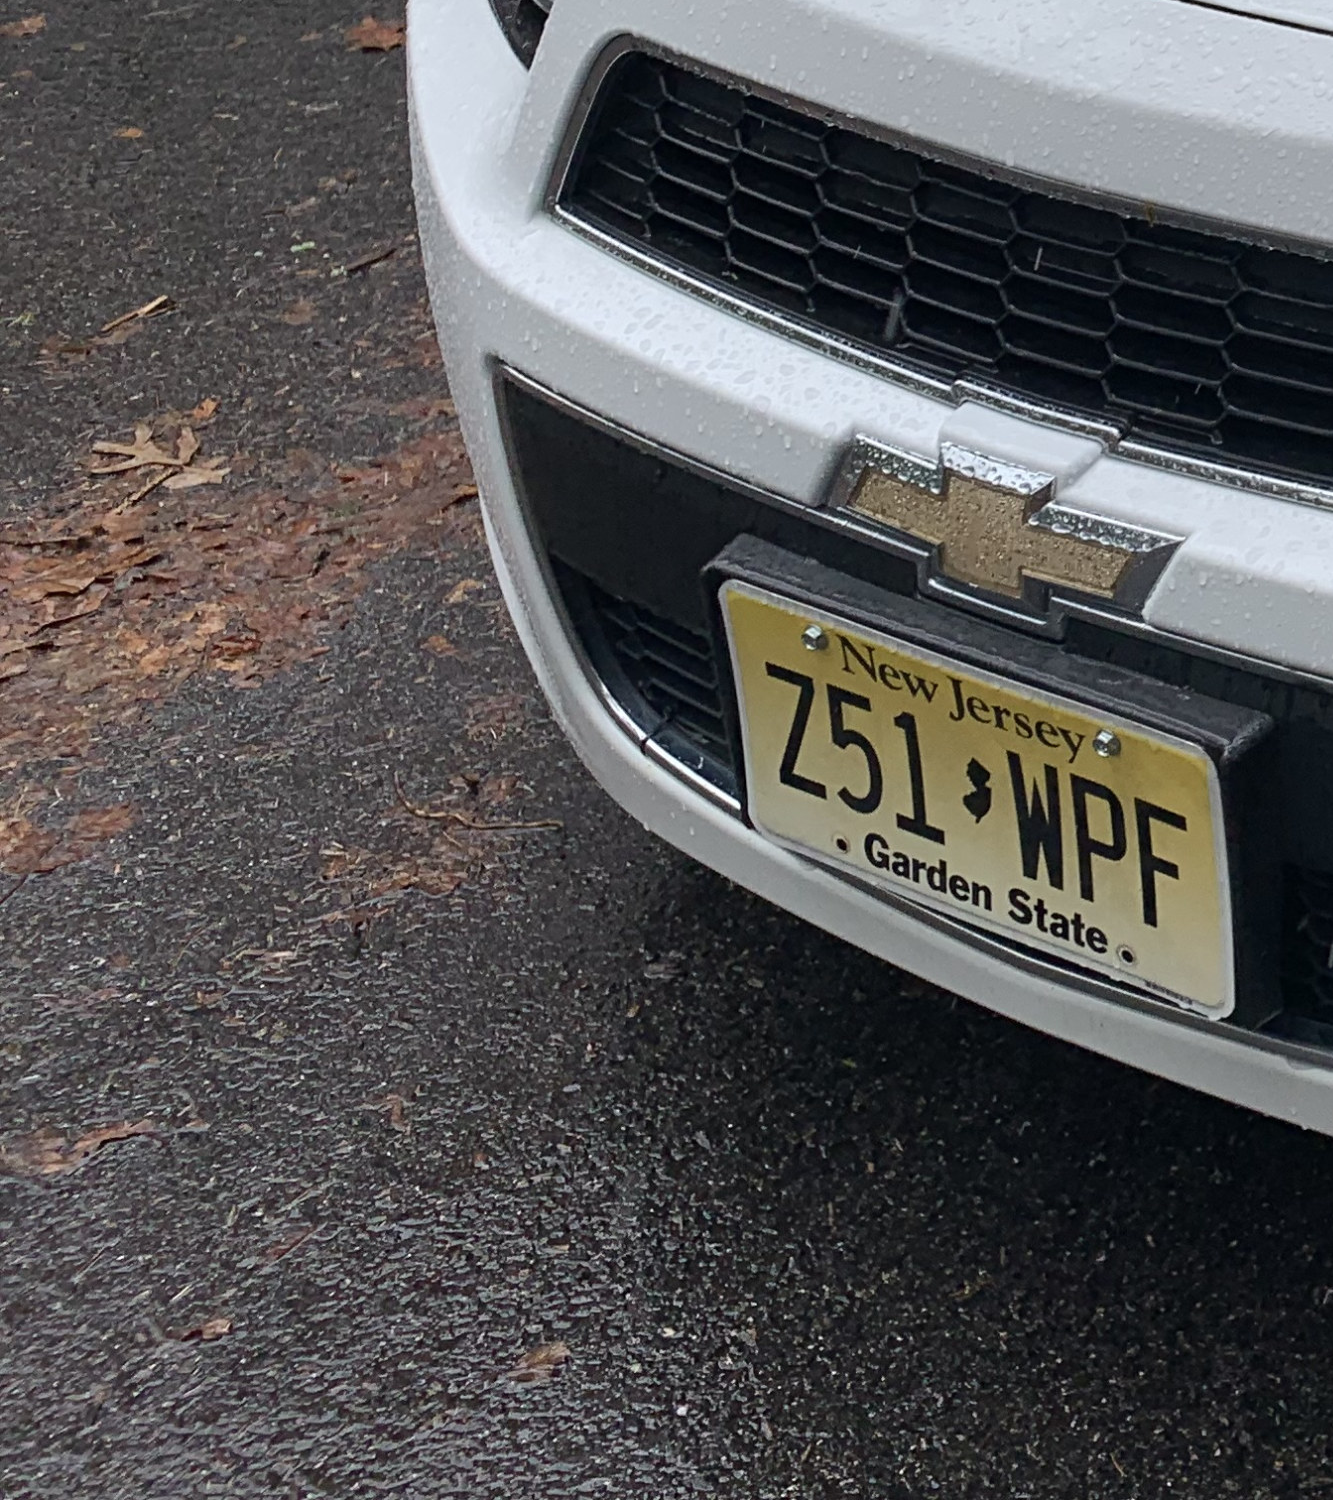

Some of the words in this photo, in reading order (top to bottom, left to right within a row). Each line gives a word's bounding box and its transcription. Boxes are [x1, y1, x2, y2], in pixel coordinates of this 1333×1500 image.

[836, 634, 939, 703] New
[947, 674, 1086, 764] Jersey
[765, 661, 945, 845] Z51
[1006, 750, 1187, 927] WPF
[863, 832, 993, 912] Garden
[1007, 887, 1109, 954] State
